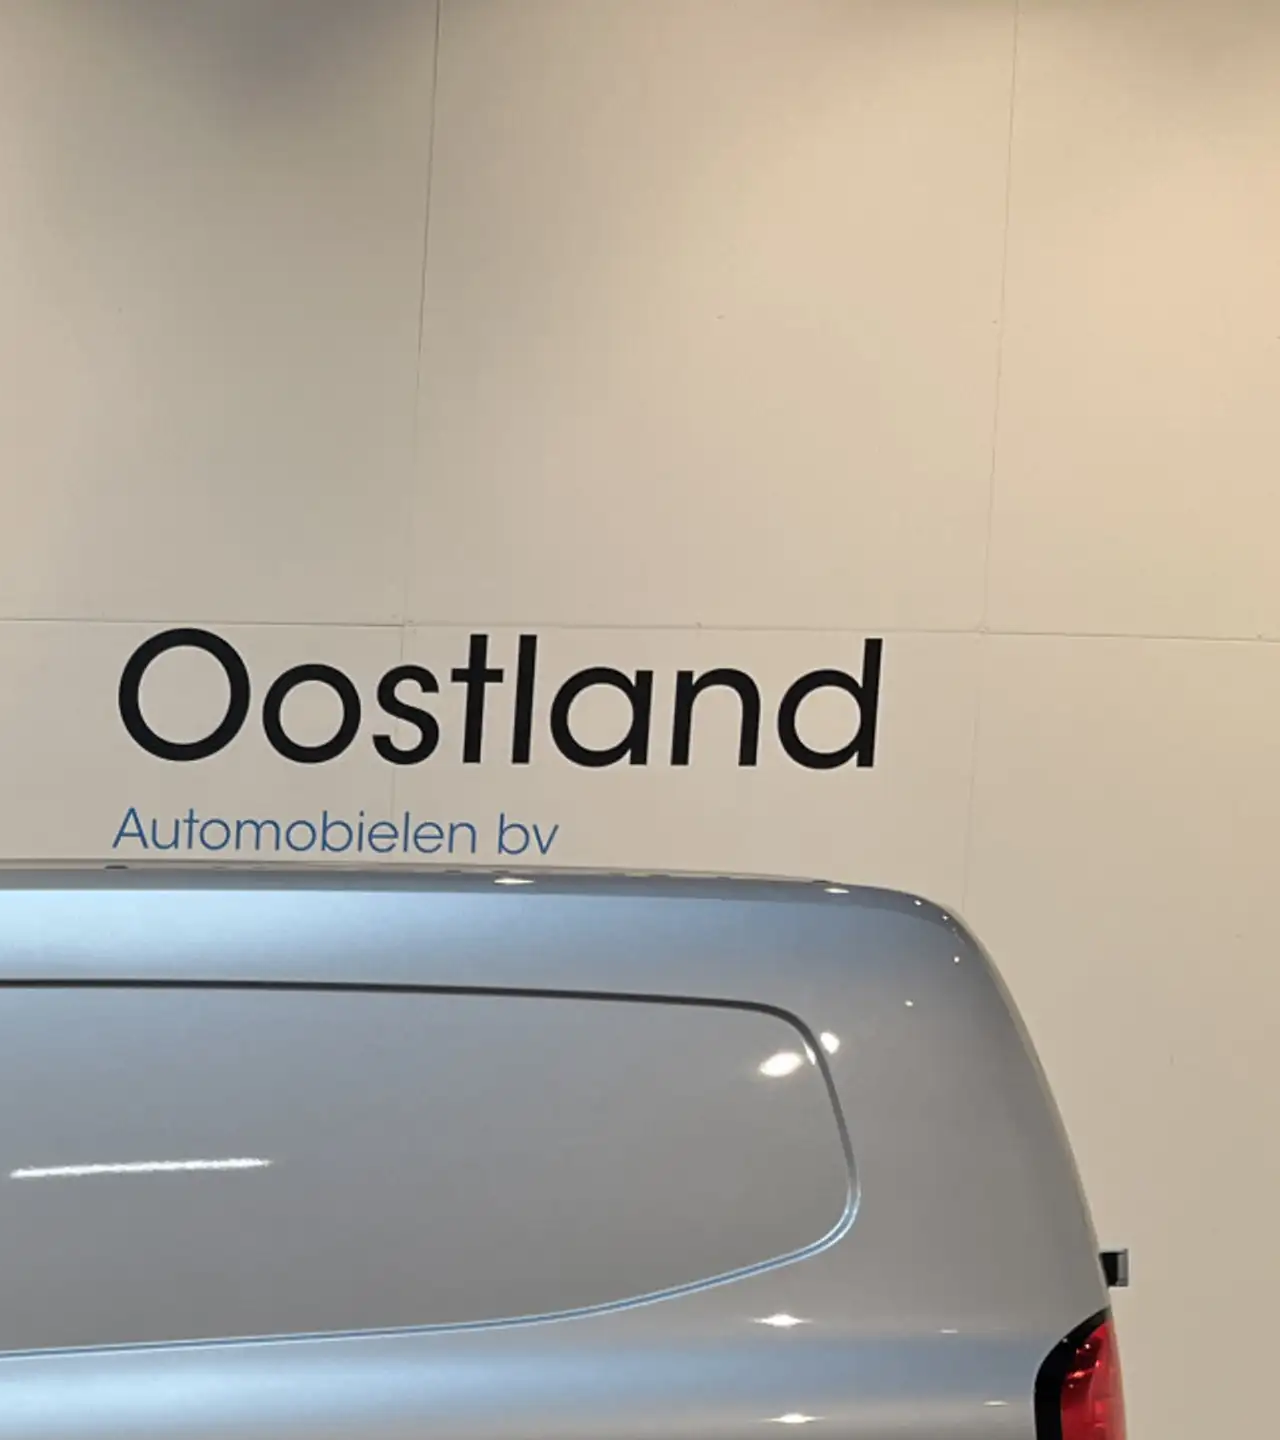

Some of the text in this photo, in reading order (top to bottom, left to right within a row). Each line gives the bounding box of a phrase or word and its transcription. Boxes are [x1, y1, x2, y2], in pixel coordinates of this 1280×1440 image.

[118, 627, 883, 770] Oostland
[111, 806, 559, 857] Automobielen bv
